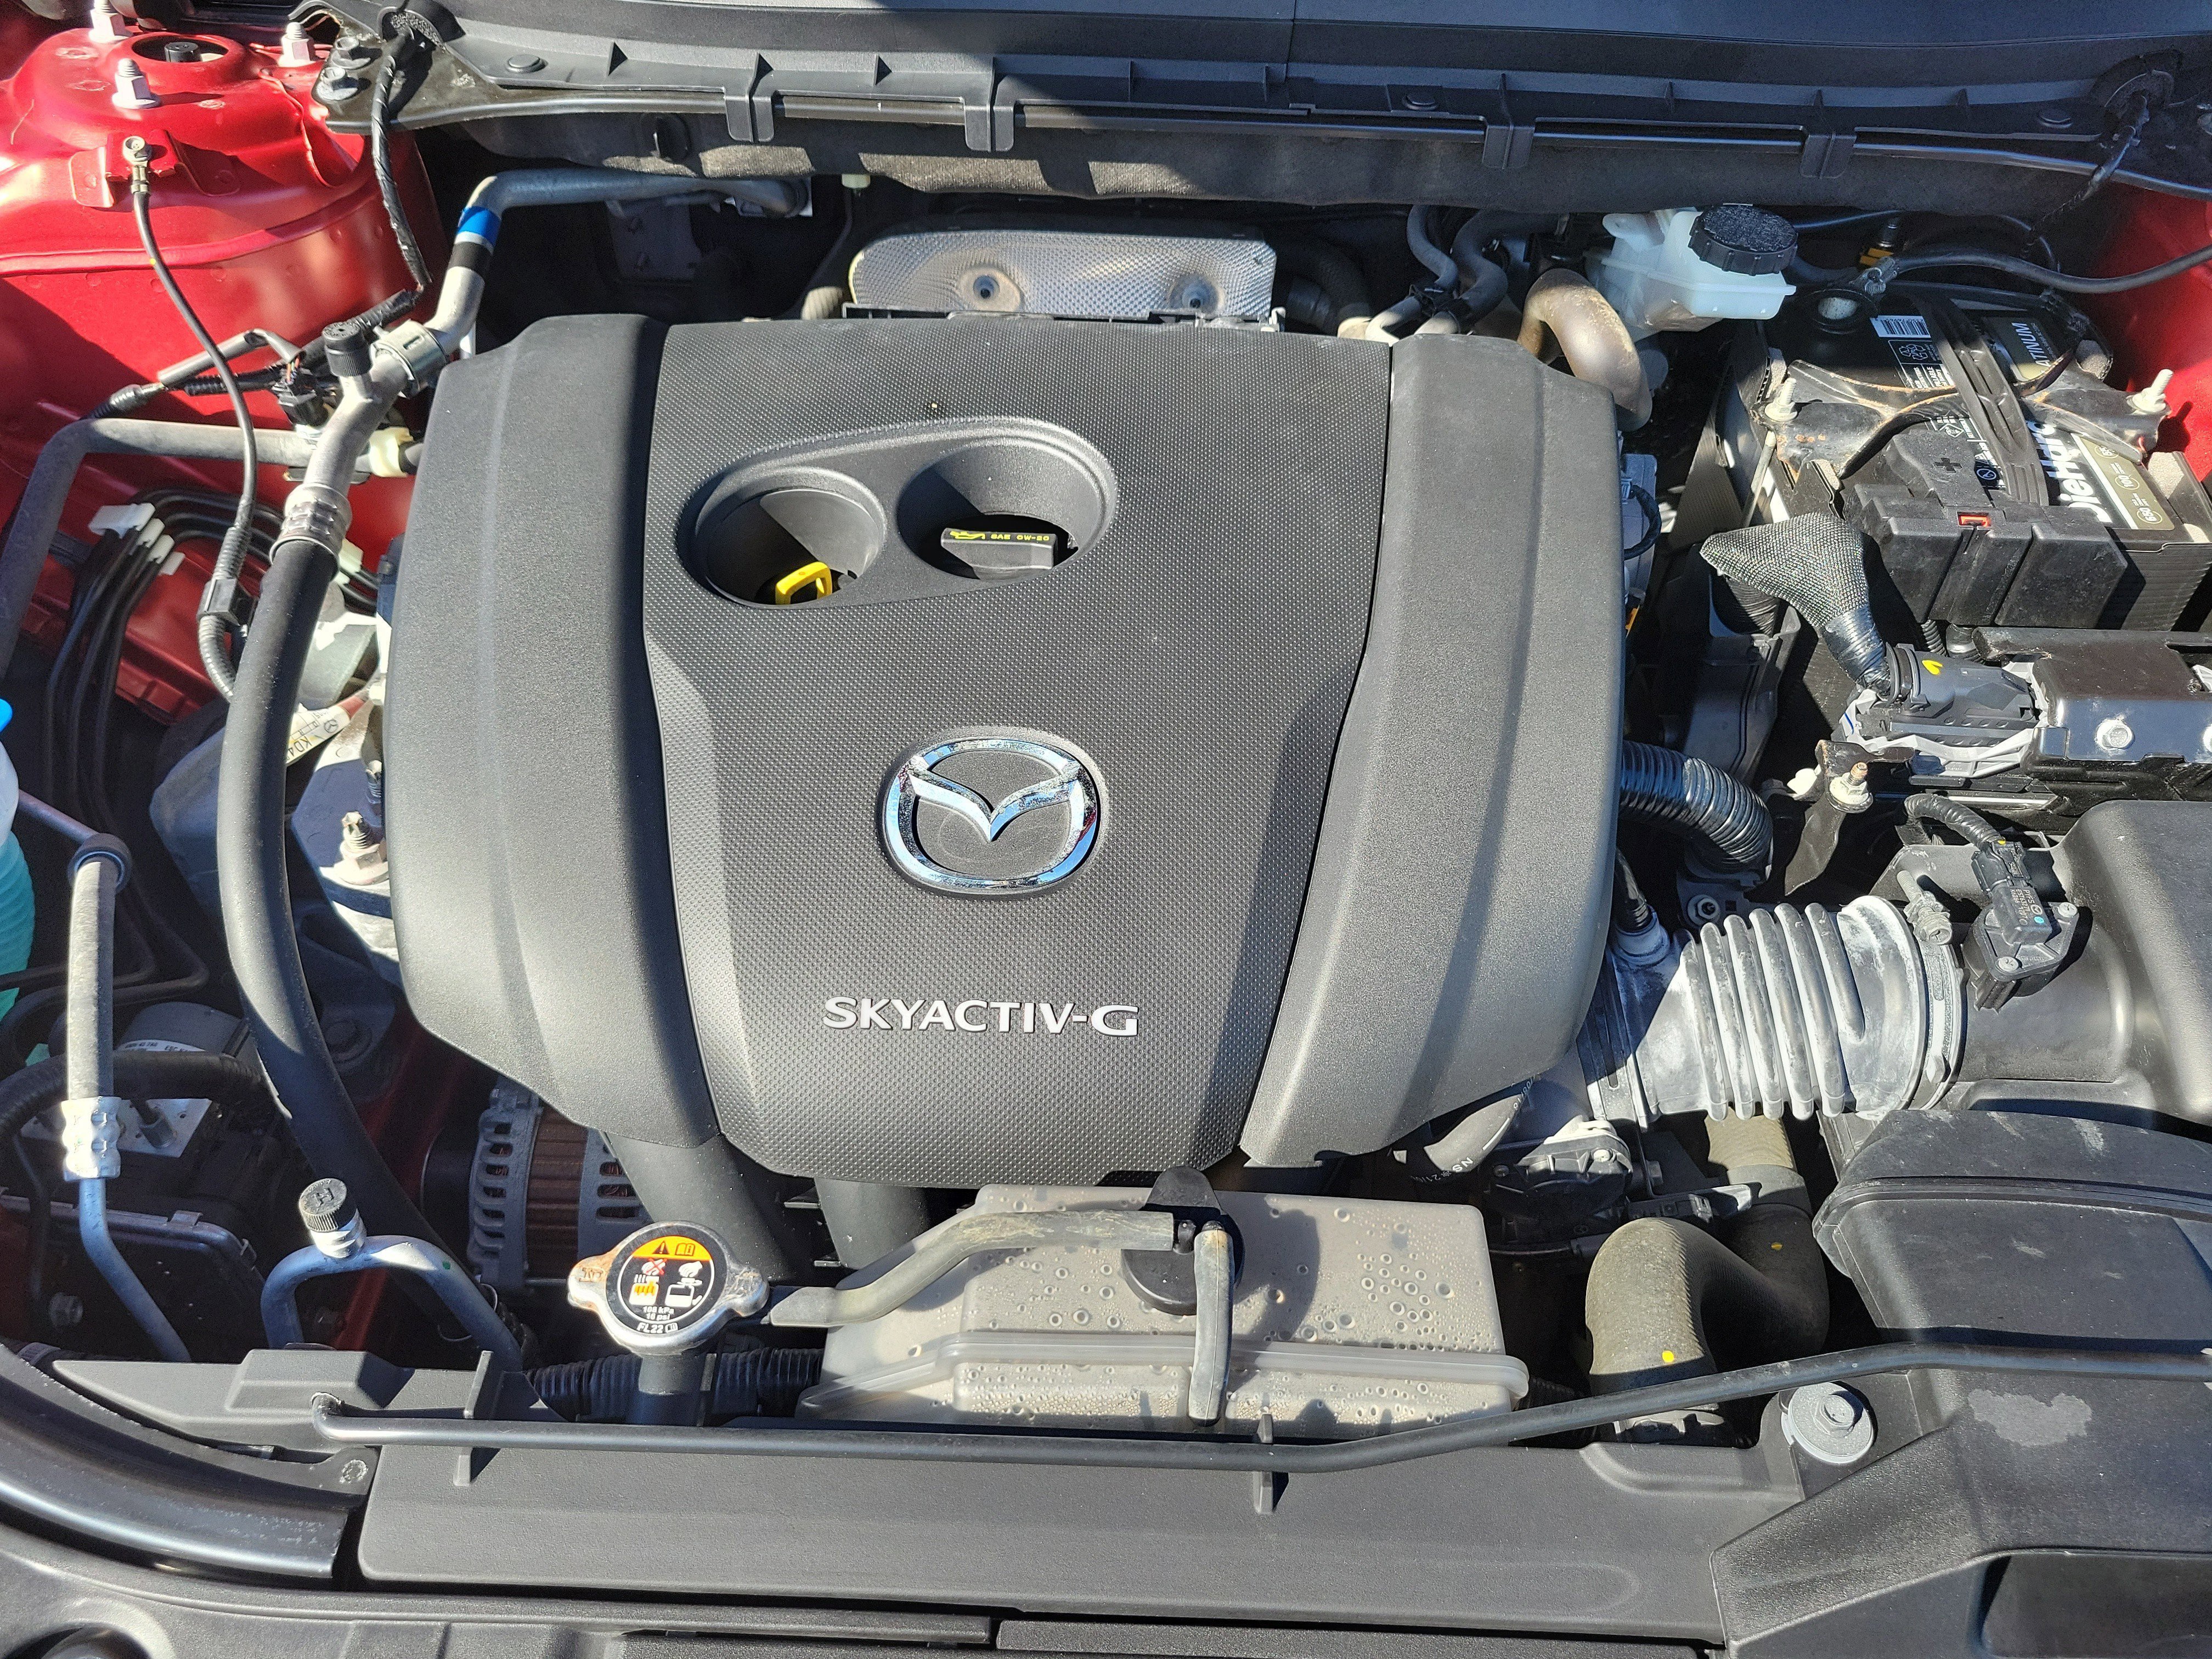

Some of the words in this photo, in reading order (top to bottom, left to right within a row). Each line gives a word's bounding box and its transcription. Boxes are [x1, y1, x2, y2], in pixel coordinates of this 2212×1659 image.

[2011, 323, 2052, 368] ATINUM
[823, 996, 1139, 1037] SKYACTIV-G
[658, 1306, 674, 1314] kPa
[636, 1322, 664, 1334] FL22
